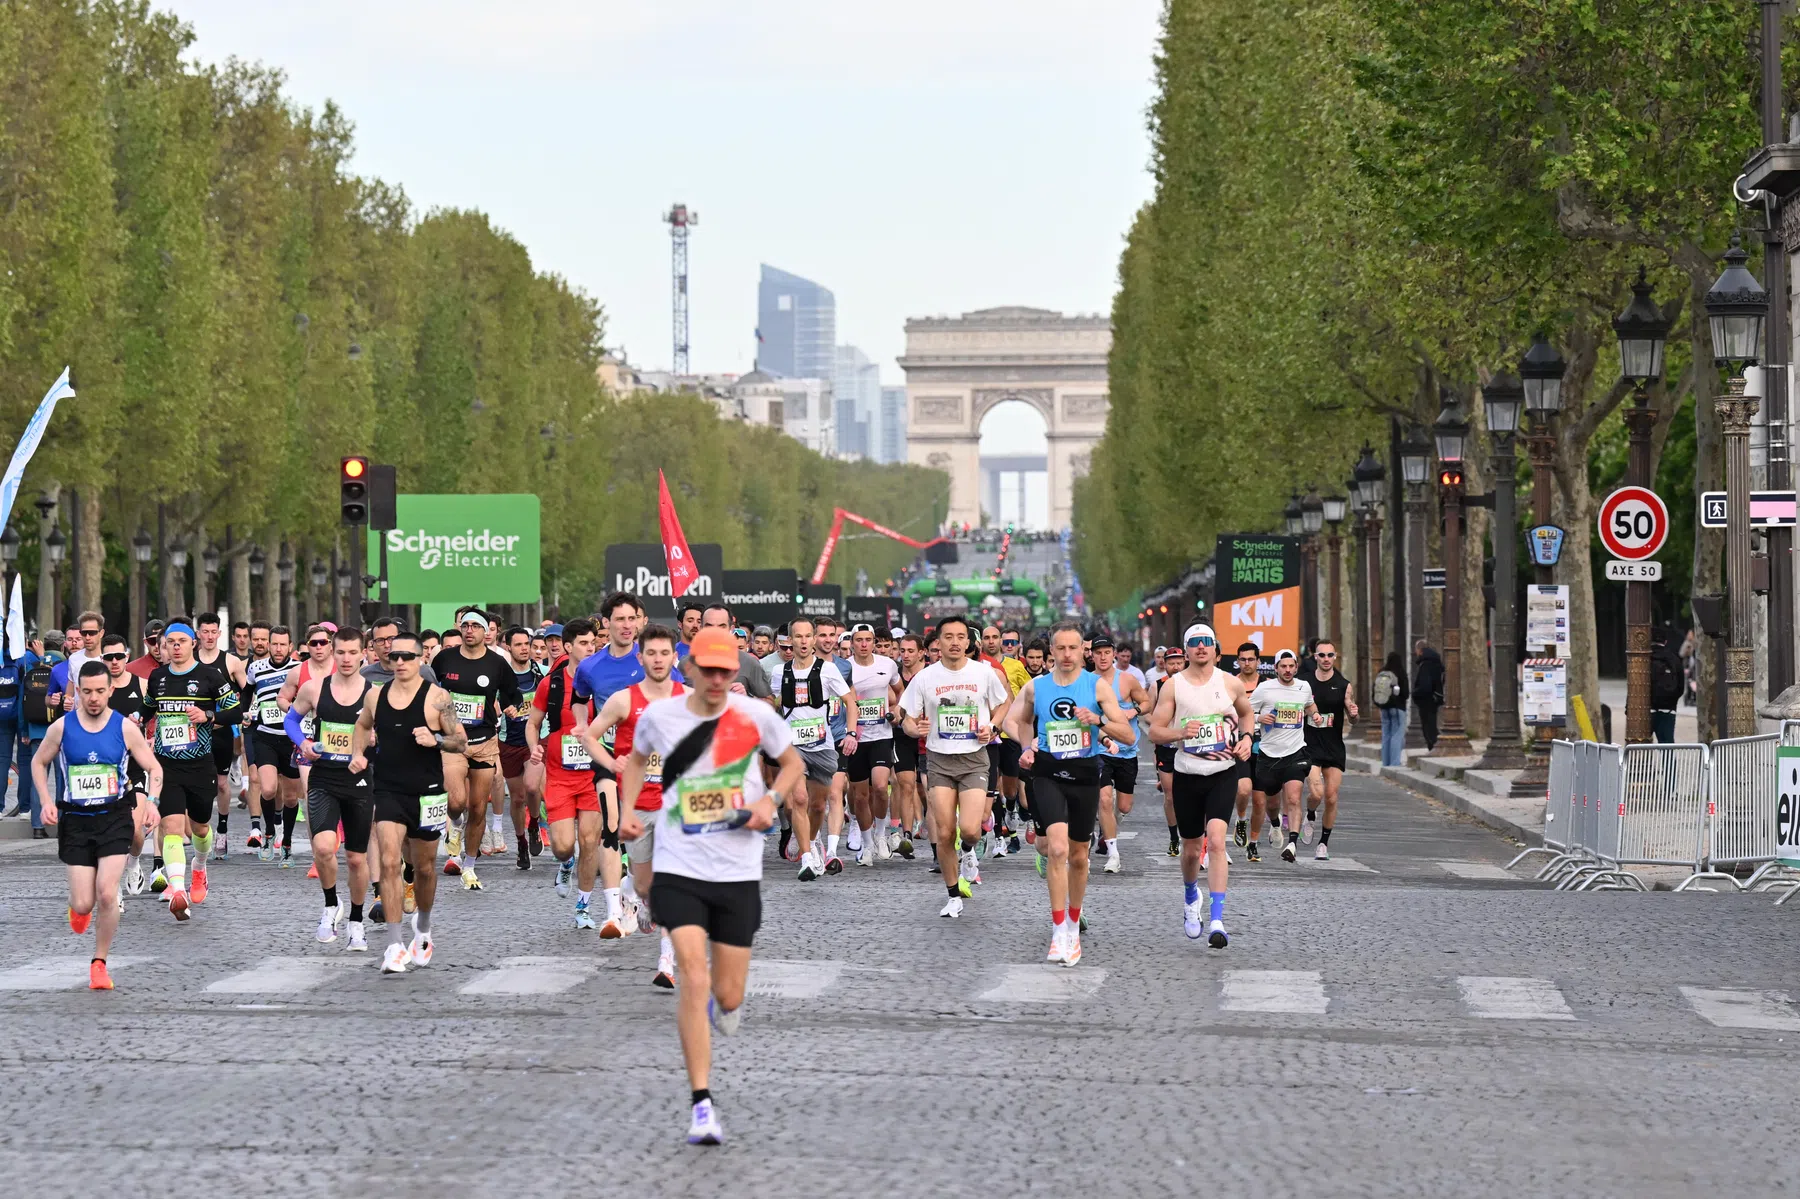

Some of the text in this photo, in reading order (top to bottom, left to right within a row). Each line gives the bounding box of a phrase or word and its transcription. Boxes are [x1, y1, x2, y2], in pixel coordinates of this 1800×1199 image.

[1614, 511, 1653, 539] 50
[387, 528, 520, 552] Schneider
[1232, 540, 1285, 551] Schneider
[444, 553, 517, 567] Electric
[1232, 557, 1284, 571] MARATHON
[1238, 566, 1284, 584] PARIS
[1612, 566, 1656, 576] AXE 50
[1231, 594, 1284, 627] KM
[1248, 631, 1264, 652] 1
[446, 672, 460, 680] ABB
[944, 716, 965, 728] 1674
[1278, 710, 1296, 720] 11980
[164, 726, 184, 740] 2218
[796, 728, 815, 738] 1645
[1053, 733, 1078, 747] 7500
[327, 734, 349, 748] 1466
[78, 776, 102, 790] 1448
[689, 792, 724, 812] 8529
[1777, 767, 1800, 846] ei
